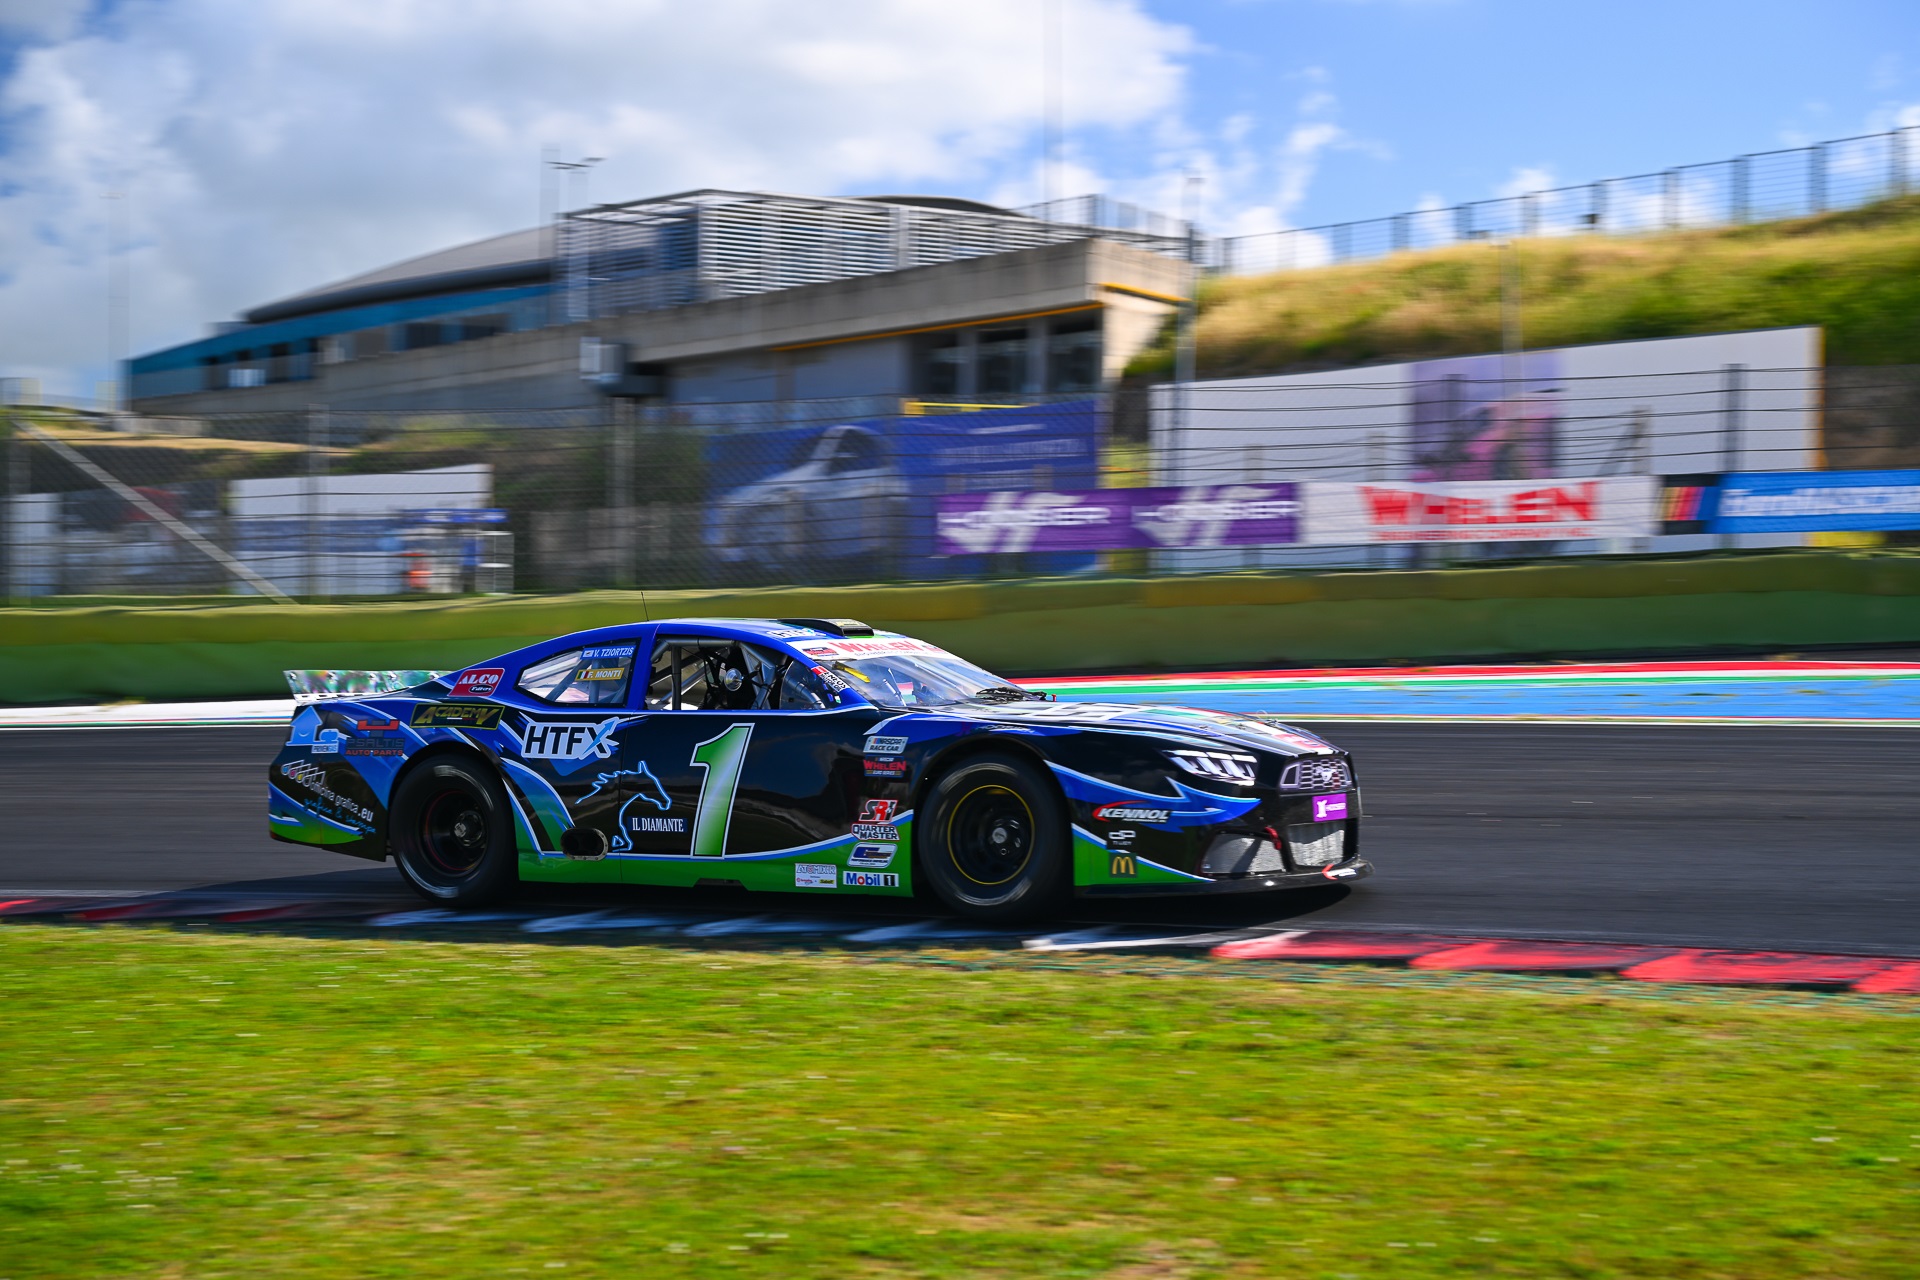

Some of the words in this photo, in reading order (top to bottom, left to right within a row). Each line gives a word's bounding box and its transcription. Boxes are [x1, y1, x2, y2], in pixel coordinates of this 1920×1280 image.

[594, 649, 599, 658] V.
[601, 647, 634, 657] TZIORTZIS
[459, 674, 499, 685] ALCO
[595, 670, 621, 679] MONTI
[414, 706, 500, 725] ACADEMY
[524, 717, 619, 757] HTFX
[347, 738, 405, 748] PSALTIS
[863, 759, 907, 771] WHELEN
[690, 723, 755, 859] 1
[1098, 808, 1169, 819] KENNOL
[632, 817, 641, 831] IL
[642, 818, 684, 832] DIAMANTE
[853, 825, 895, 834] QUARTER
[860, 831, 897, 840] MASTER
[846, 872, 881, 886] Mobil
